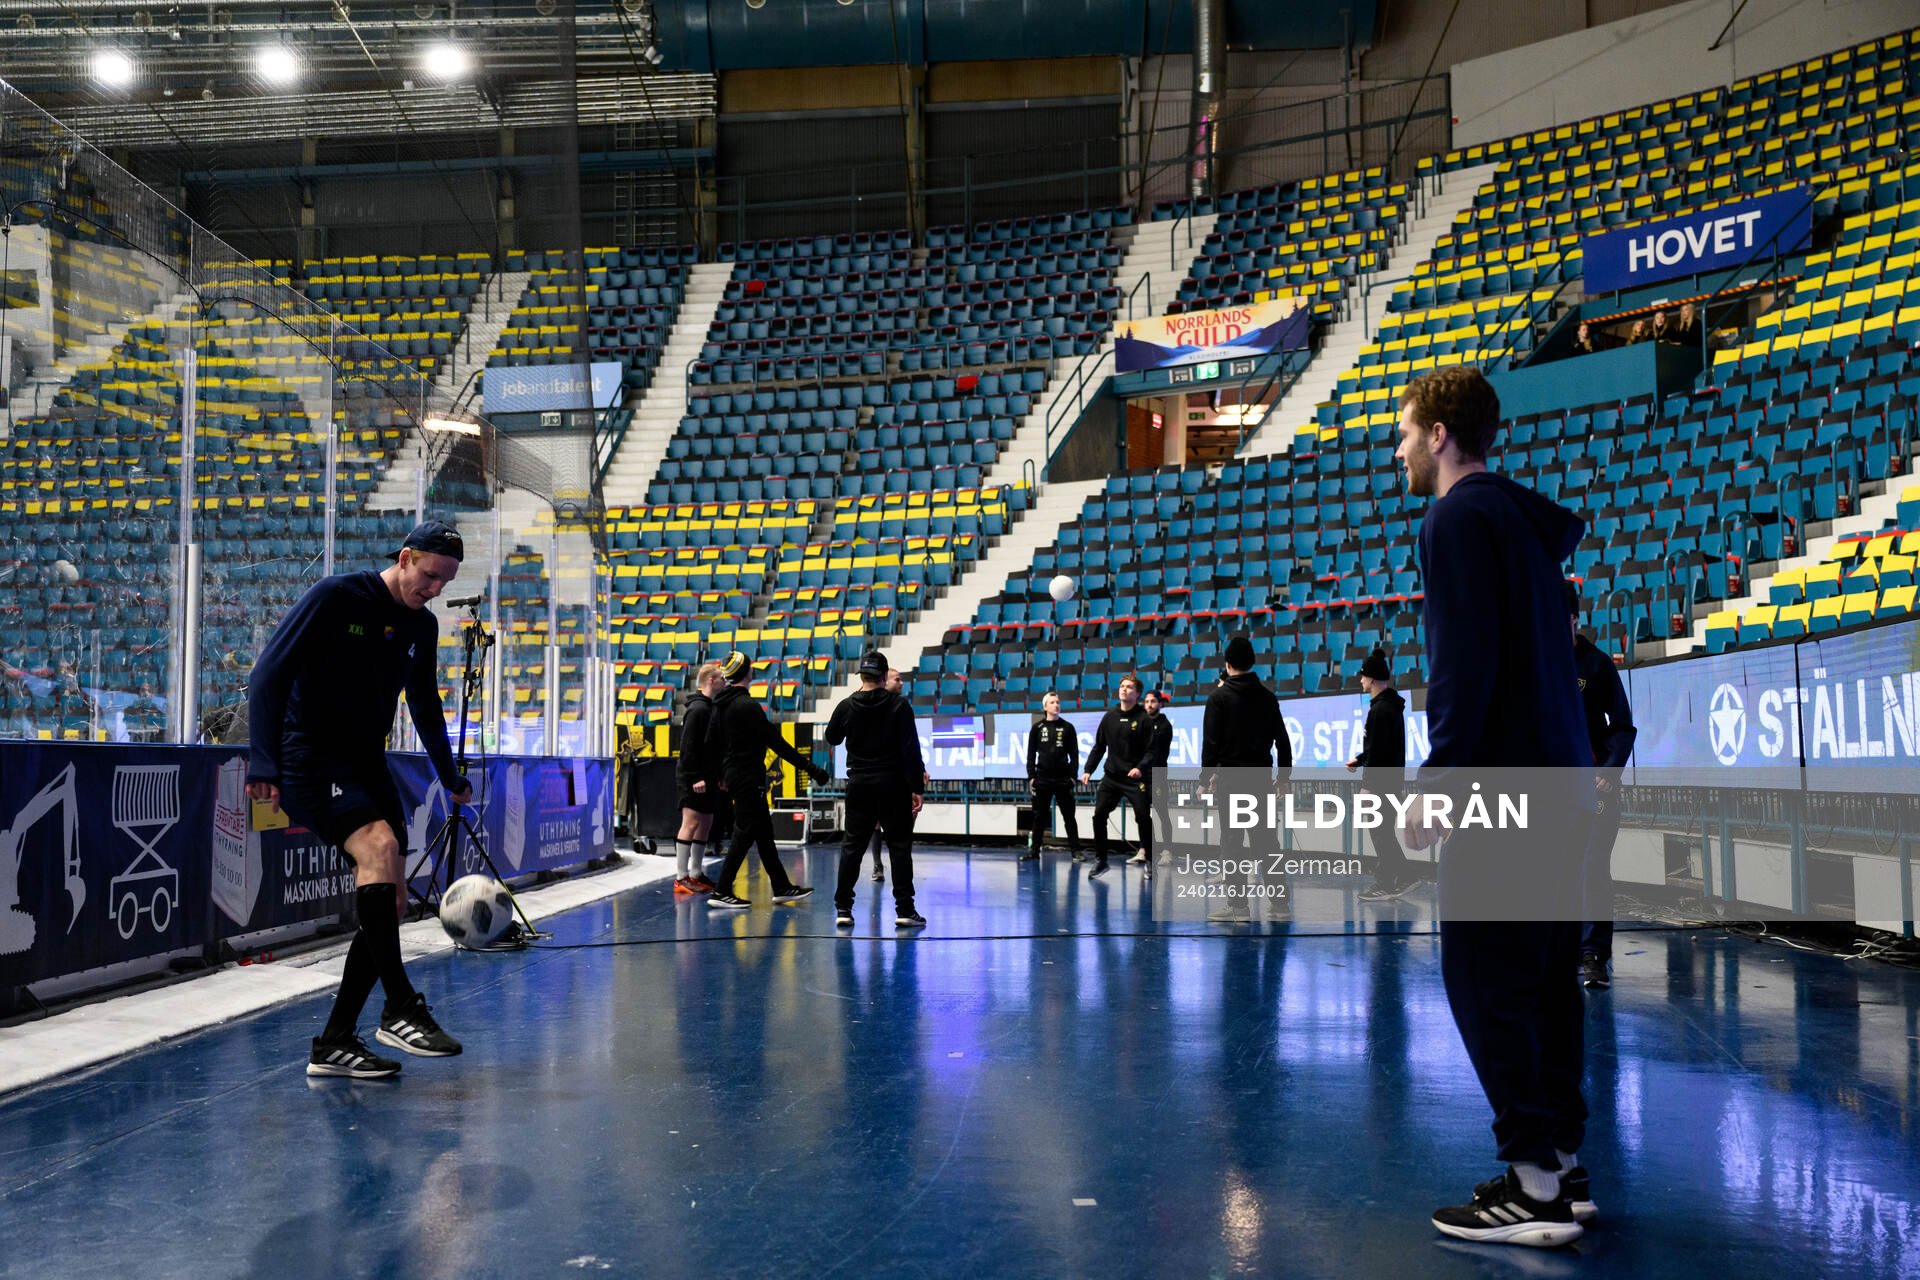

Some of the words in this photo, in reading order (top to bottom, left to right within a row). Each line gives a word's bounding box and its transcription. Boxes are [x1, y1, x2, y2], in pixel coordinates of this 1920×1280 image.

[1629, 210, 1761, 273] HOVET
[1165, 308, 1252, 336] NORRLANDS
[1176, 323, 1243, 347] GULD
[348, 623, 364, 636] XXL
[331, 783, 343, 798] 4
[283, 877, 330, 905] MASKINER
[331, 876, 338, 897] &
